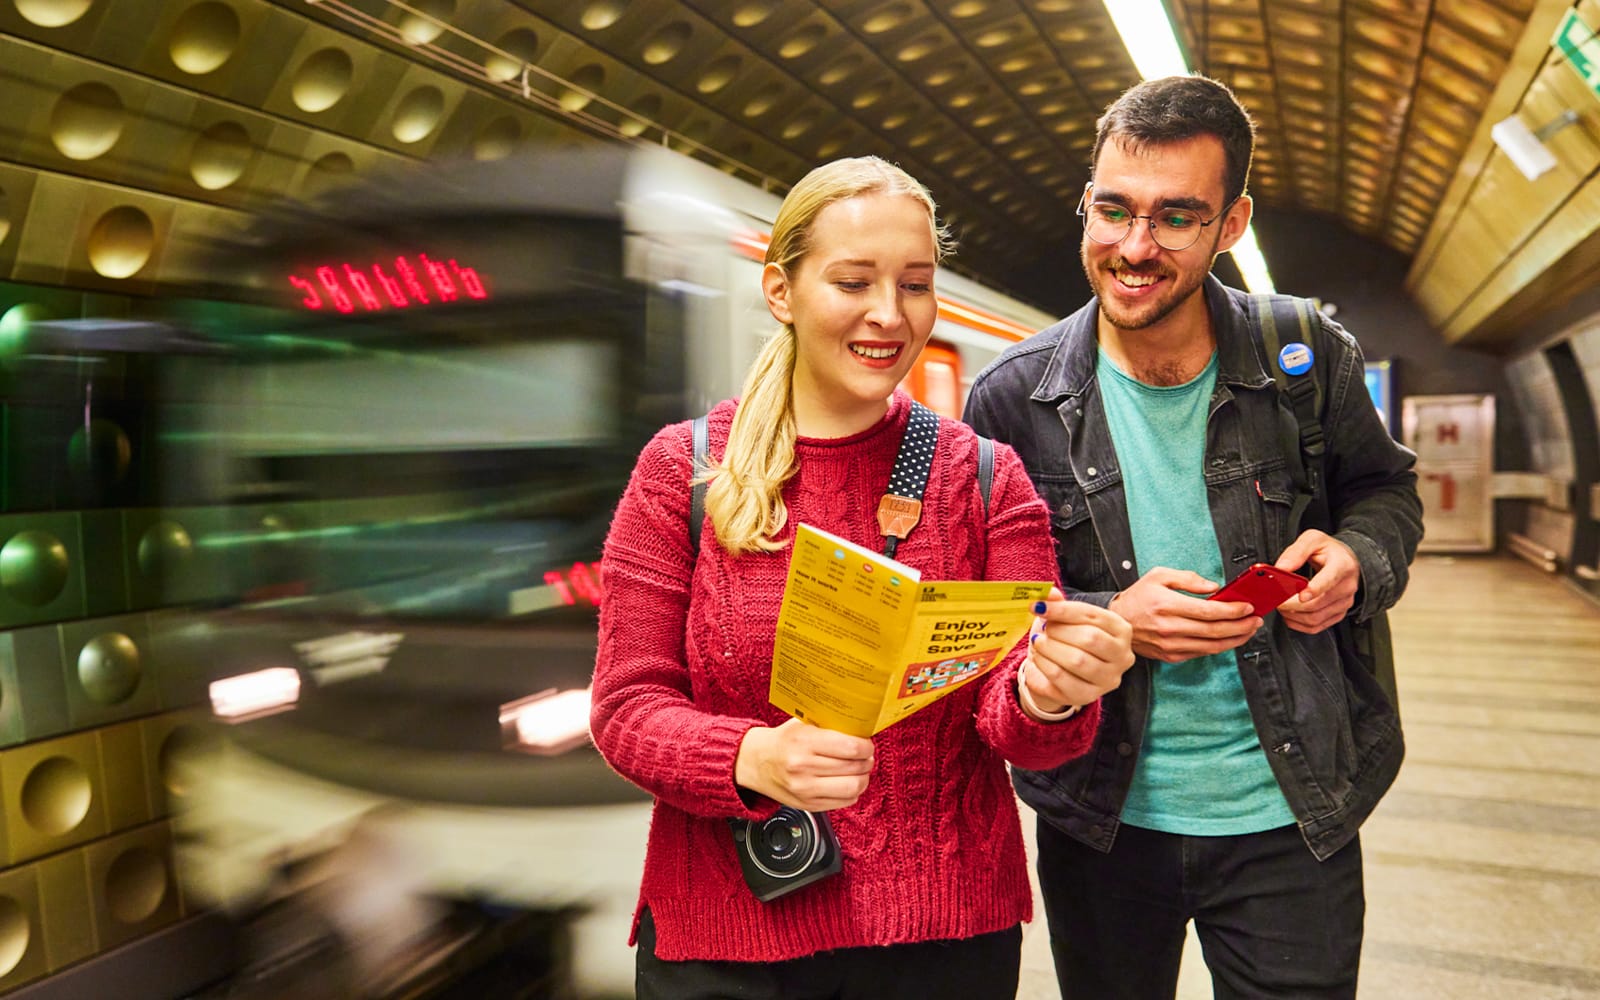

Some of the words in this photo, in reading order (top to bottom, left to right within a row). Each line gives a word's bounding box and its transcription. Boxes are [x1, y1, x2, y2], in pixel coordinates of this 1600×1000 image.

[934, 620, 990, 633] Enjoy
[931, 631, 1007, 643] Explore
[927, 644, 976, 654] Save
